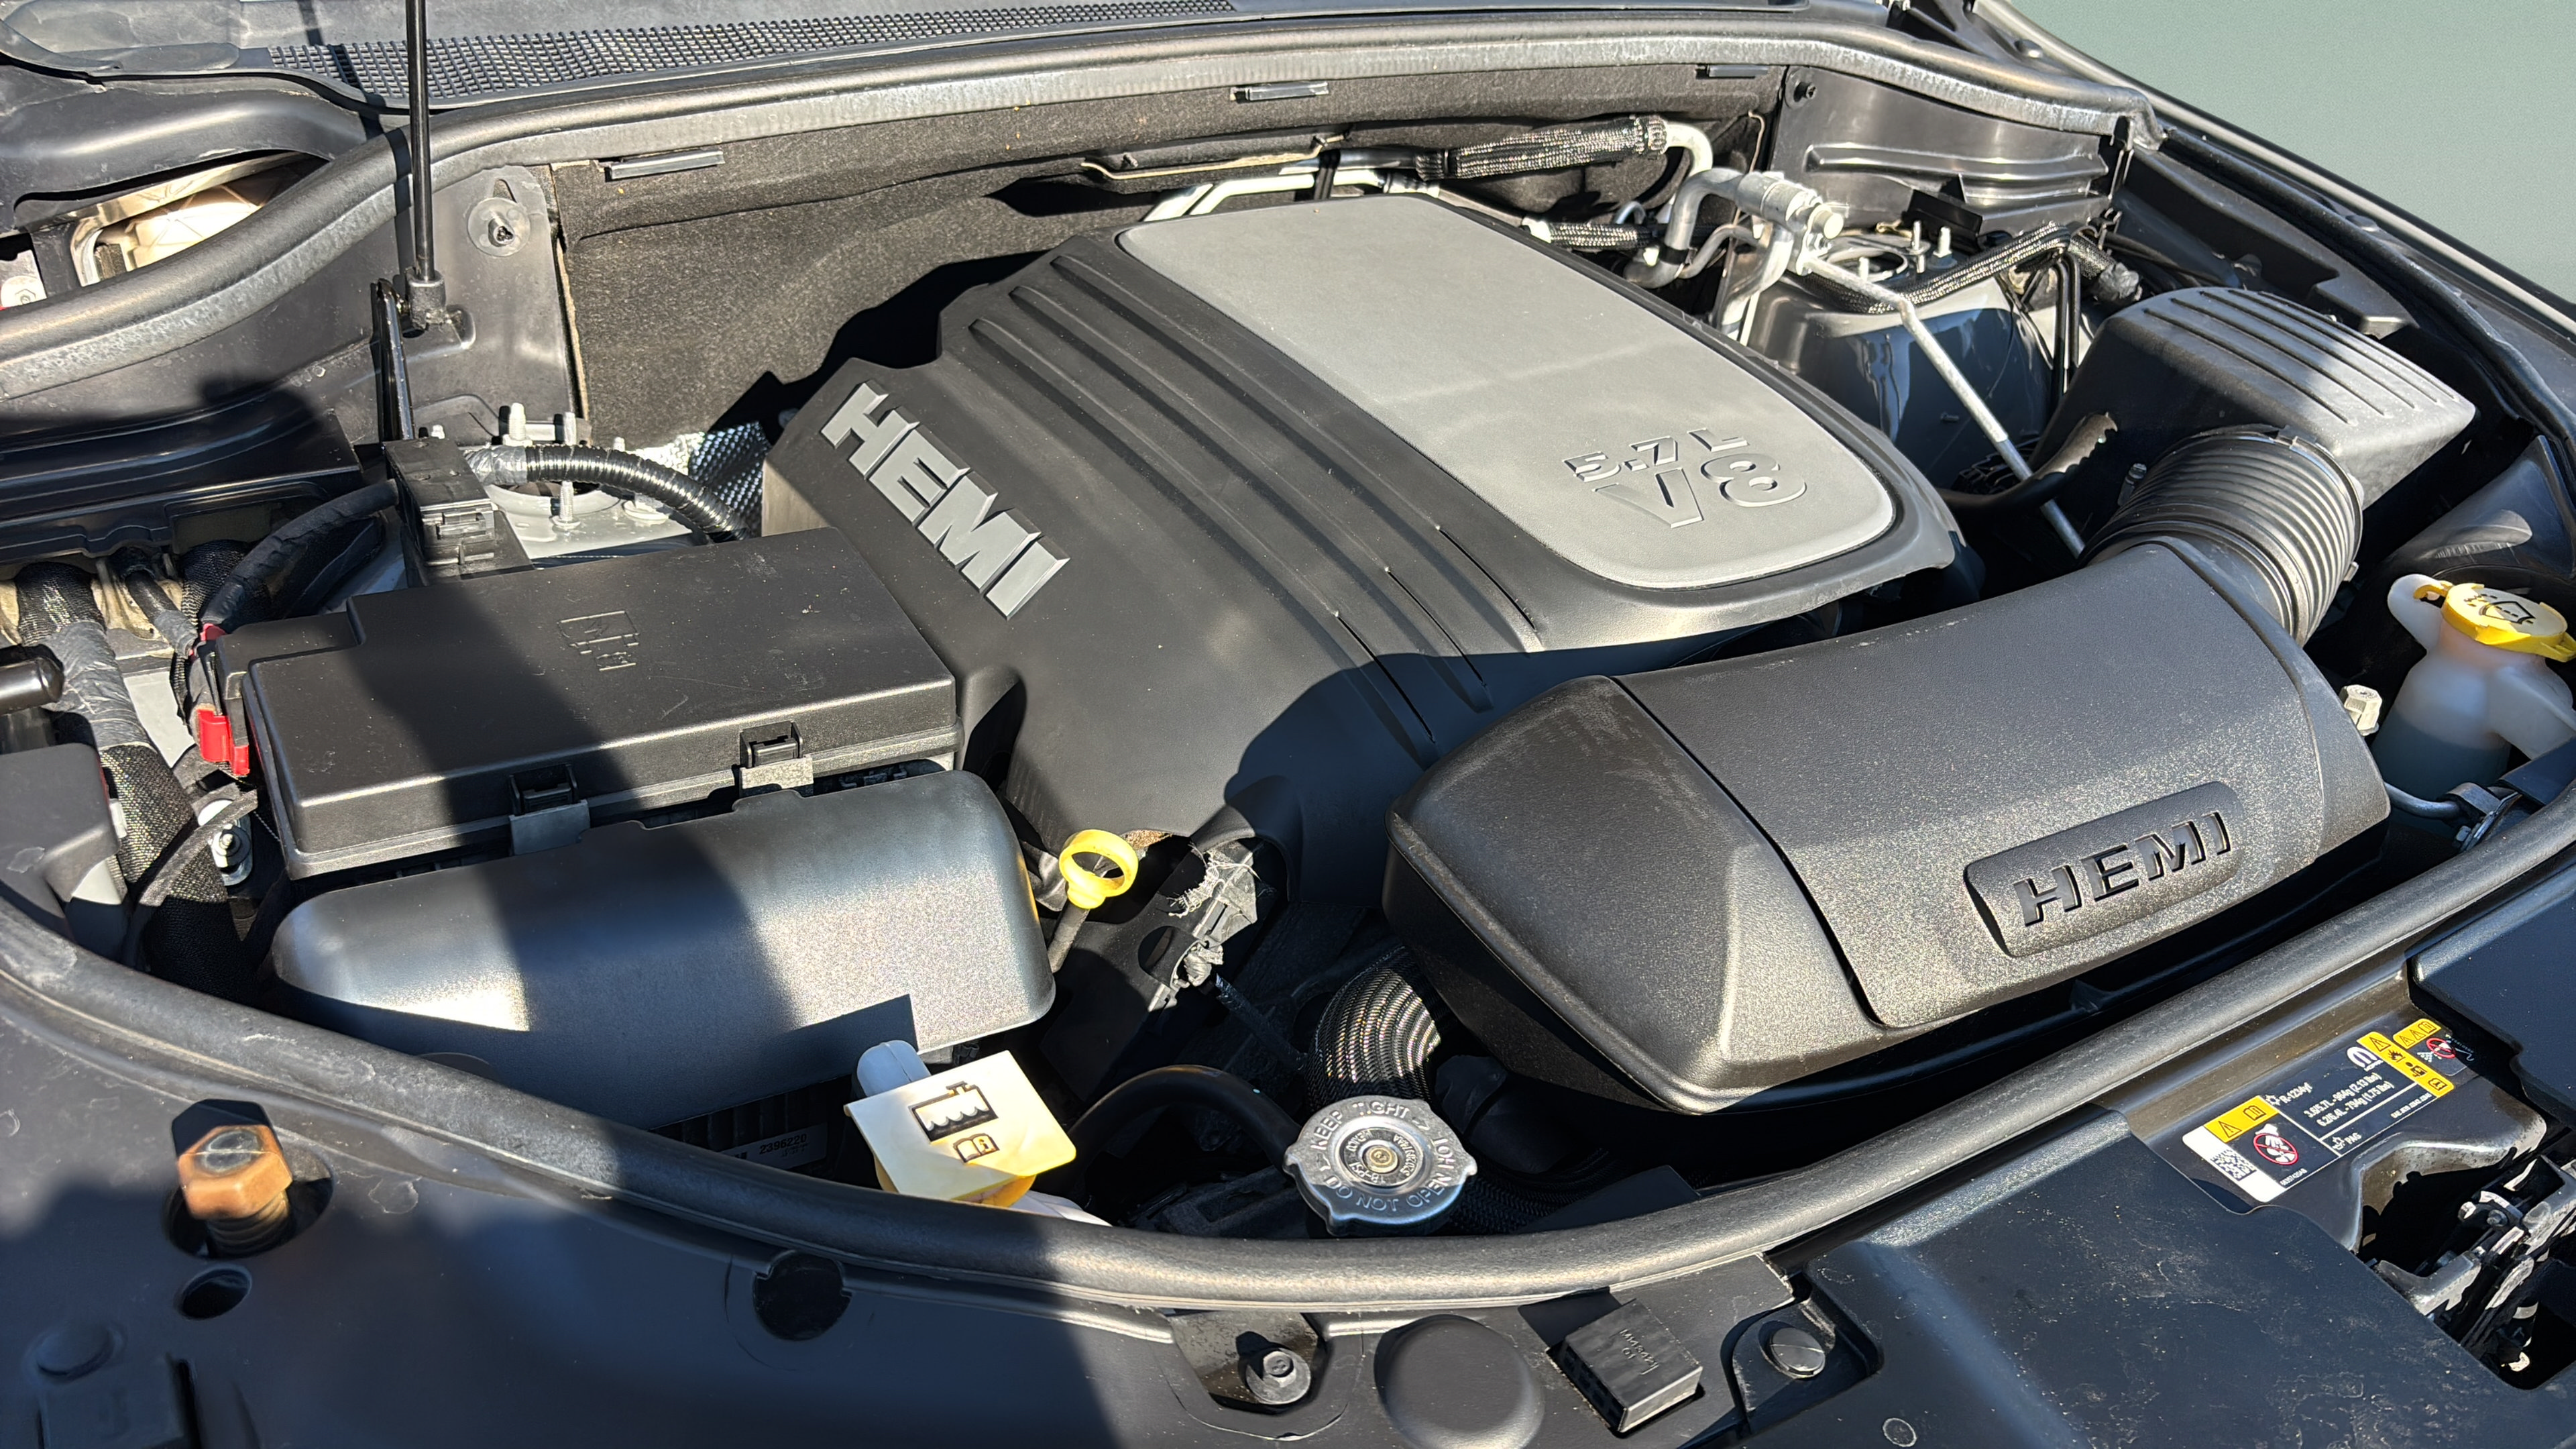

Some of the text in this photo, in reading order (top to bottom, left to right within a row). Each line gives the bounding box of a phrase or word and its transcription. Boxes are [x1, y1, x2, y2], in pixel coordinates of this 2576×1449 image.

[820, 379, 1070, 621] HEMI
[1591, 452, 1807, 529] V8
[2013, 810, 2232, 926] HEMI
[2279, 1082, 2313, 1104] R-1234yf
[2303, 1099, 2335, 1118] 3.6/5.7L
[2333, 1089, 2355, 1102] 964g
[2349, 1079, 2369, 1093] (2.13
[2316, 1108, 2347, 1127] 6.2/6.4L
[2345, 1097, 2368, 1110] 794g
[2361, 1087, 2381, 1102] (1.75
[759, 1133, 807, 1155] 2396220
[1310, 1109, 1344, 1150] KEEP
[2344, 1132, 2362, 1145] PAG
[1323, 1136, 1455, 1212] DO NOT OPEN HOT
